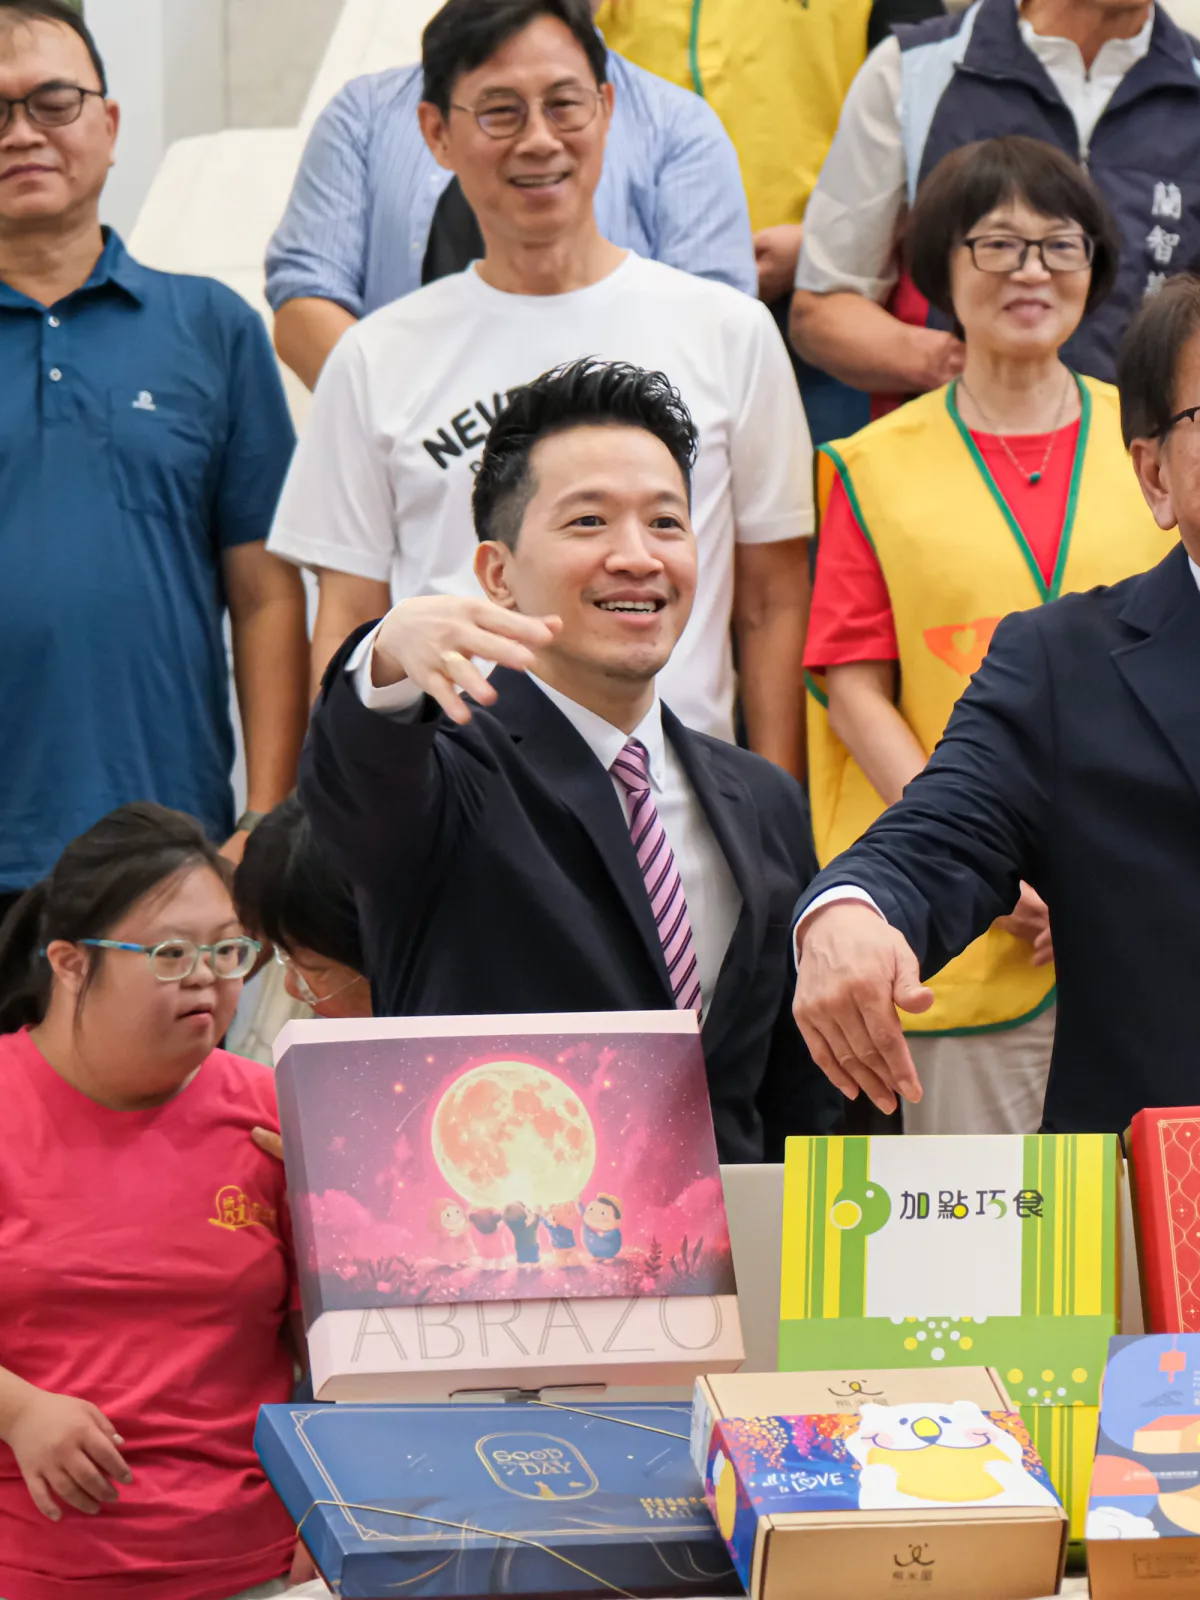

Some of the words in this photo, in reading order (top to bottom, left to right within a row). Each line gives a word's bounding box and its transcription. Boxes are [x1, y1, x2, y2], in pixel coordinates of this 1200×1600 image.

[899, 1189, 1045, 1220] 加點巧食
[350, 1294, 724, 1364] ABRAZO
[492, 1447, 564, 1463] GOOD
